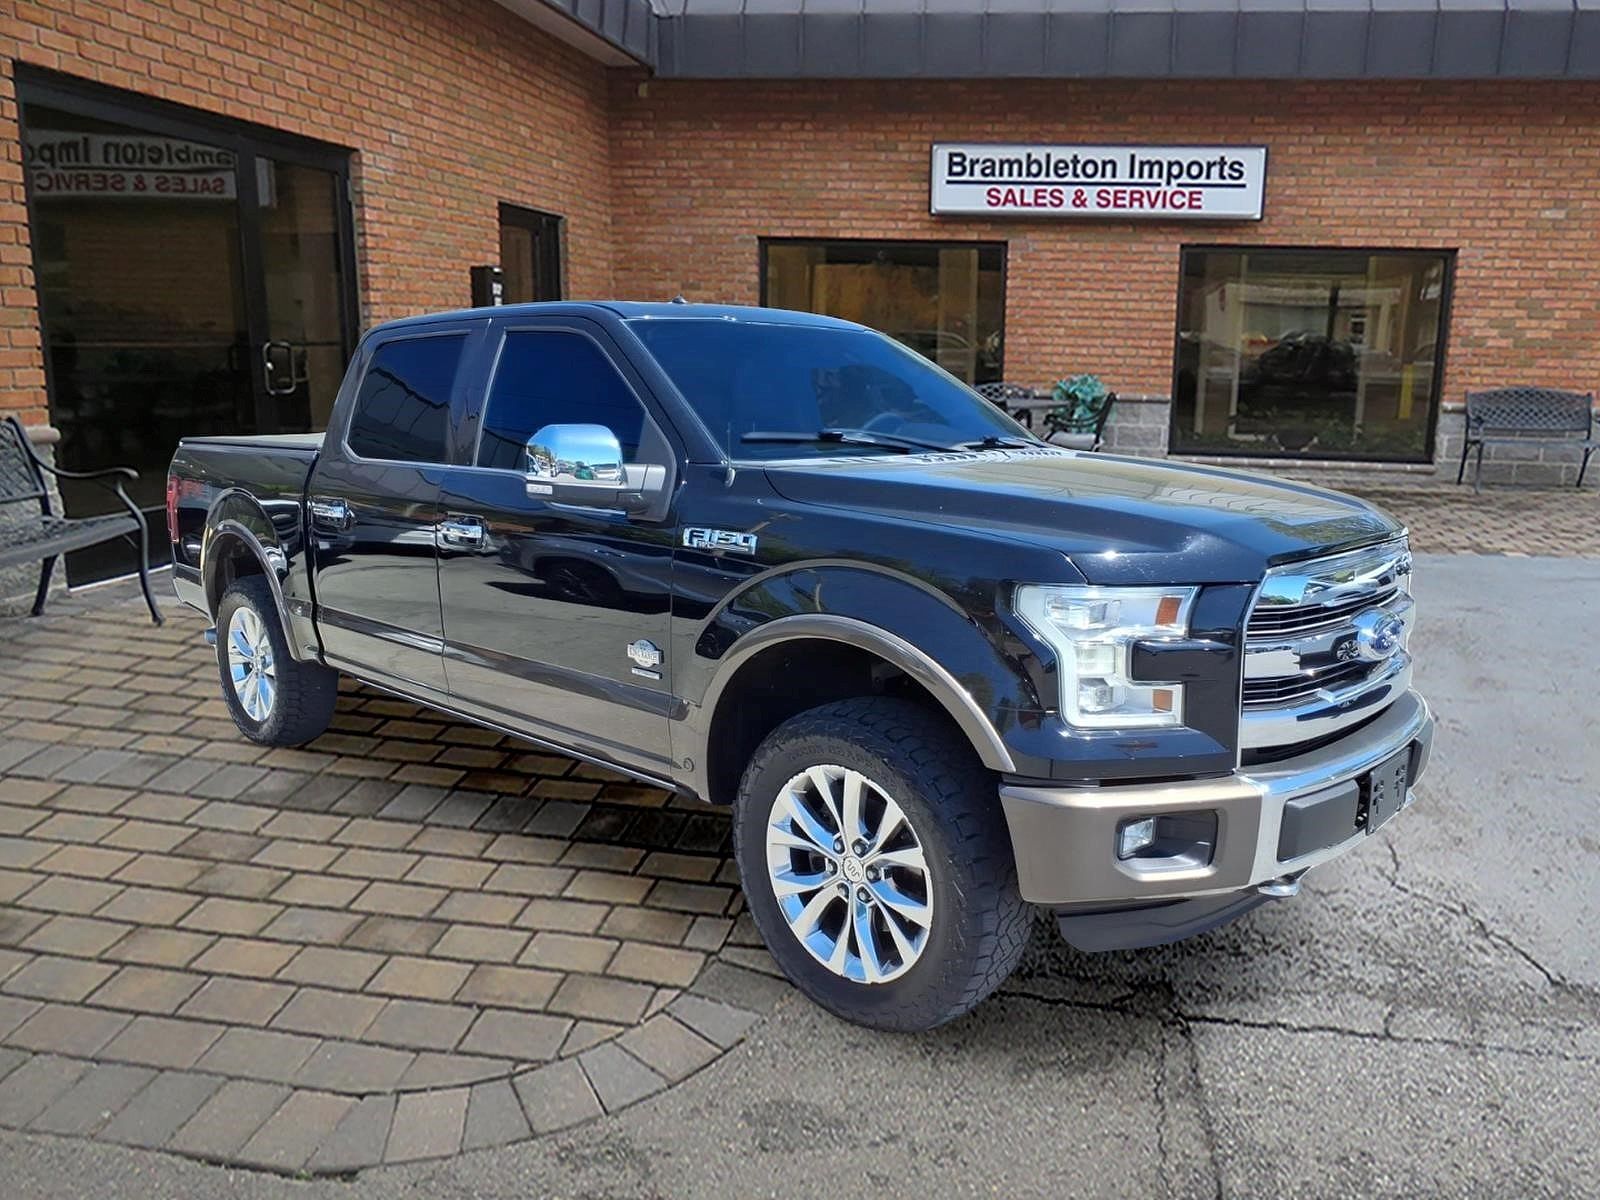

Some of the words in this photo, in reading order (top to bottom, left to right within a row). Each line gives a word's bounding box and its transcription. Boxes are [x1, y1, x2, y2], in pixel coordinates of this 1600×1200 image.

[948, 152, 1117, 179] Brambleton
[1129, 154, 1245, 186] Imports
[986, 188, 1065, 207] SALES
[1072, 189, 1088, 208] &
[1096, 189, 1203, 209] SERVICE
